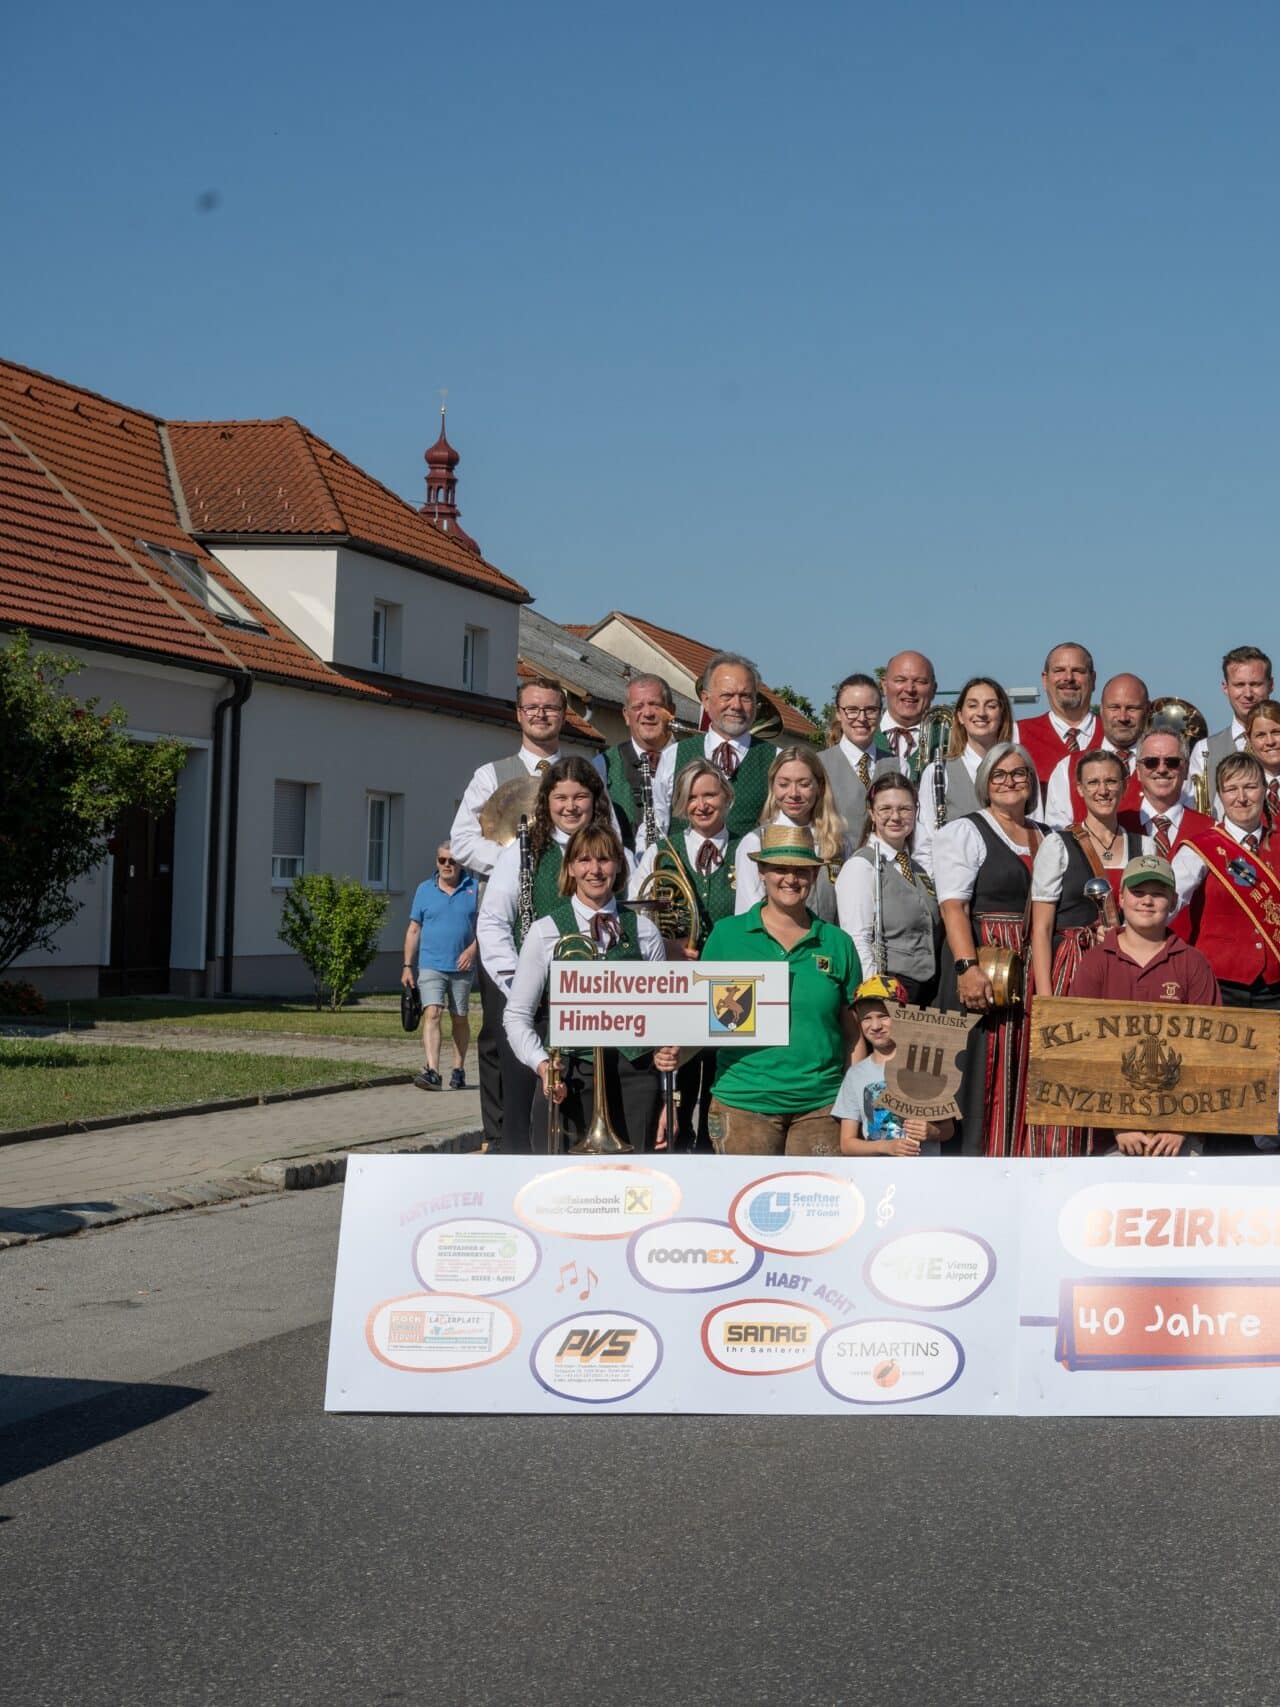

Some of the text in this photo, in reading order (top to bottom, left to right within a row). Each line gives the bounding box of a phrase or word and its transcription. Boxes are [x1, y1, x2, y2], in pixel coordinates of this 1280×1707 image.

[559, 970, 689, 994] Musikverein
[559, 1010, 647, 1037] Himberg
[894, 1009, 969, 1029] STADTMUSIK
[1096, 1013, 1259, 1050] NEUSIEDL
[881, 1093, 957, 1117] SCHWECHAT
[399, 1190, 484, 1226] TRETEN
[945, 1271, 978, 1282] Airport
[946, 1262, 978, 1270] Vienna
[765, 1271, 857, 1316] HABT ACHT
[1078, 1306, 1125, 1336] 40
[1144, 1304, 1262, 1338] Jahre
[554, 1329, 638, 1363] PVS
[727, 1325, 808, 1343] SANAG
[836, 1341, 940, 1357] ST.MARTINS
